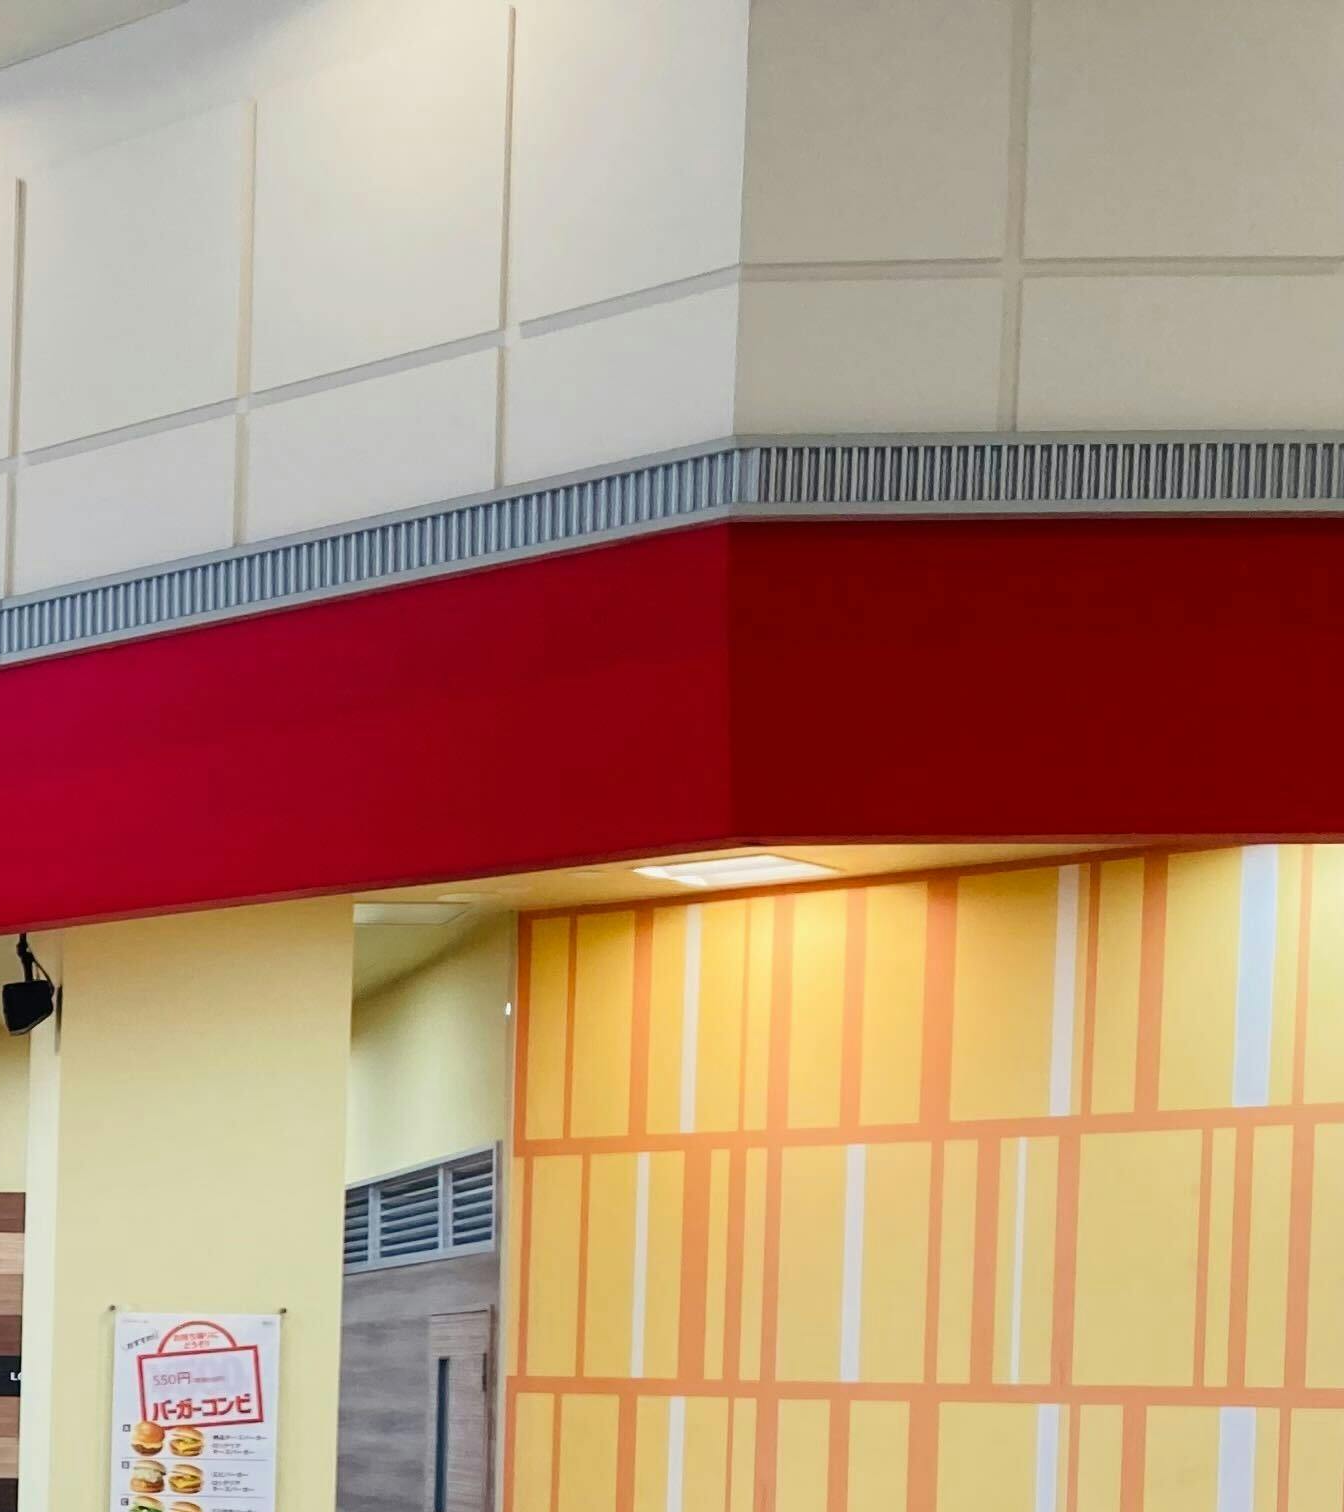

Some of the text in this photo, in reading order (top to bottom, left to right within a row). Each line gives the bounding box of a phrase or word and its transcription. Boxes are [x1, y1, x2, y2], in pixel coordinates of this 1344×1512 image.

[152, 1394, 253, 1421] バーガーコンビ
